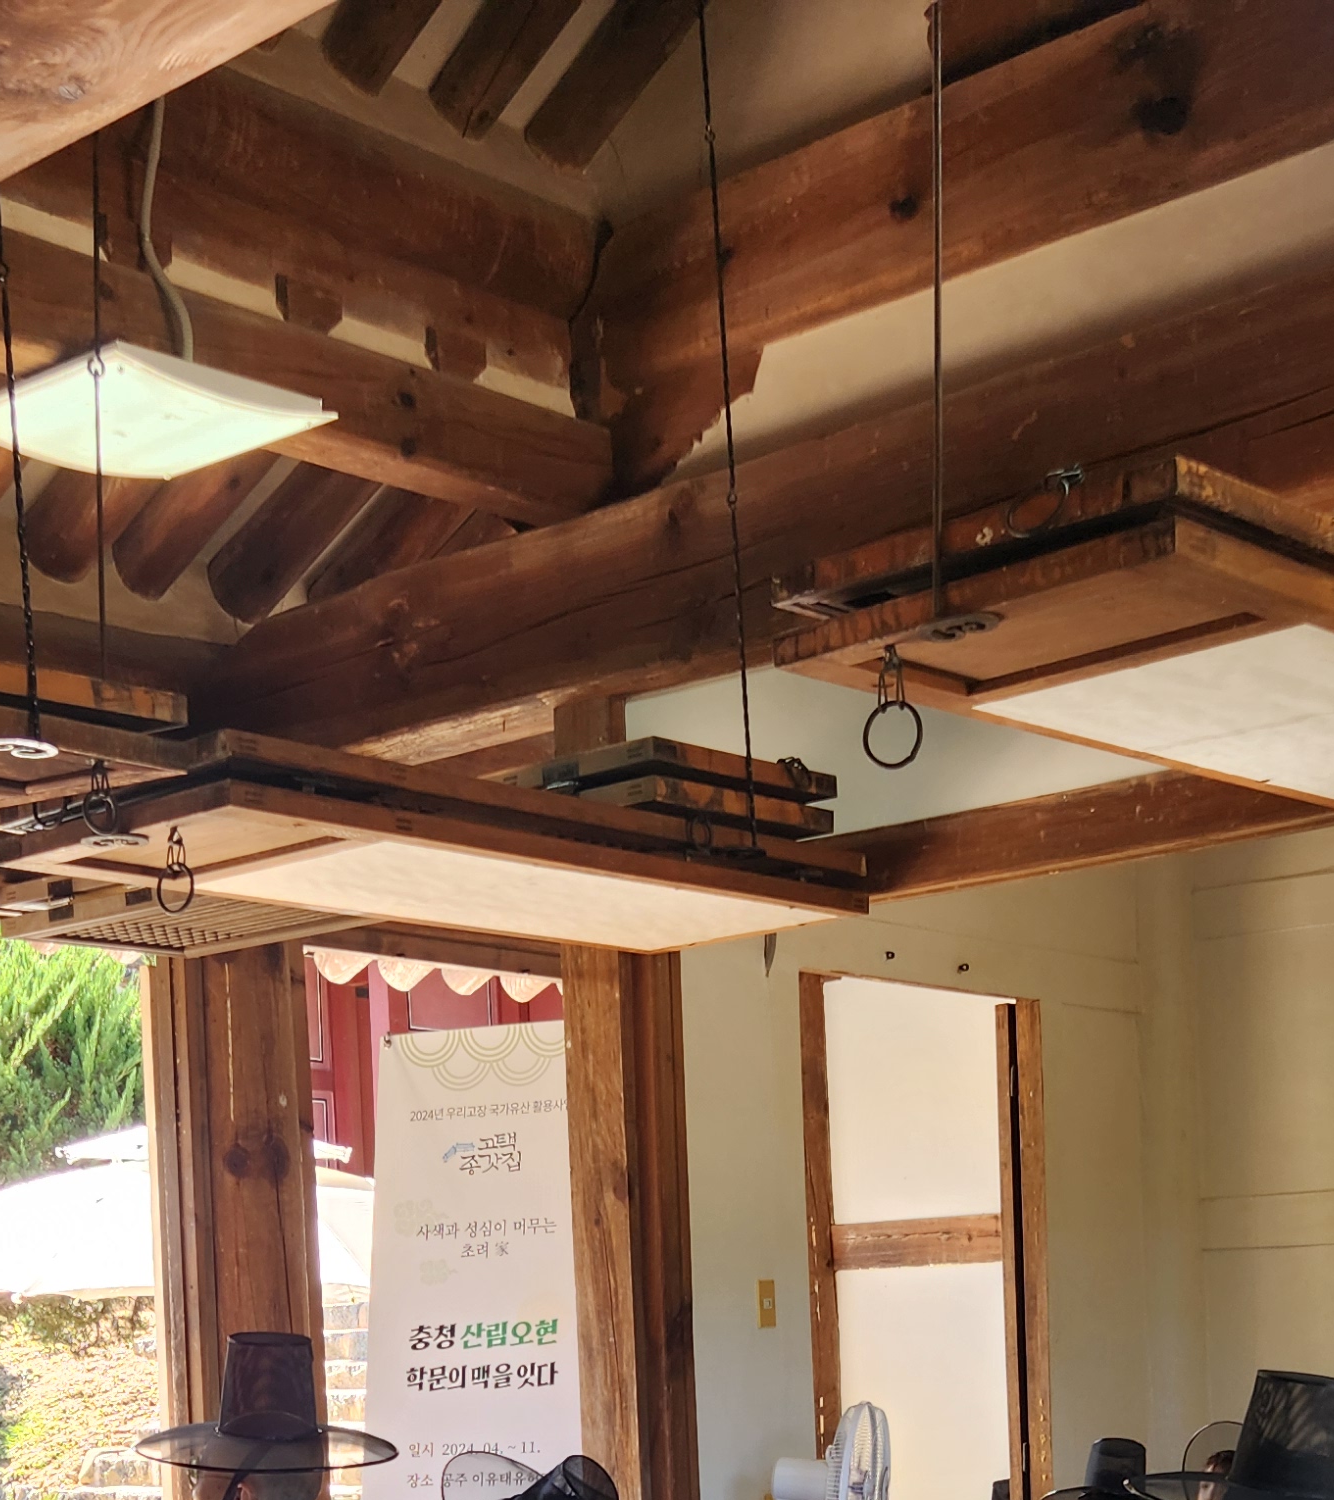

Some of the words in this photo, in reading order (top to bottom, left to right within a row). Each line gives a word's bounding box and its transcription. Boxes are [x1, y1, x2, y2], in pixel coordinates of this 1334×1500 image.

[410, 1108, 444, 1122] 2024년
[446, 1106, 487, 1119] 우리고장
[490, 1102, 530, 1116] 국가유산
[478, 1131, 517, 1151] 고택
[459, 1151, 522, 1176] 종갓집
[416, 1222, 459, 1241] 사색과
[464, 1219, 507, 1238] 성심이
[514, 1217, 557, 1236] 머무는
[461, 1241, 489, 1259] 초려
[409, 1323, 456, 1350] 충청
[460, 1318, 558, 1349] 산림오현
[406, 1365, 467, 1392] 학문의
[471, 1363, 513, 1389] 맥을
[517, 1361, 559, 1389] 잇다
[408, 1441, 434, 1458] 일시
[521, 1441, 541, 1454] 11.
[407, 1472, 434, 1489] 장소
[442, 1472, 468, 1488] 공주
